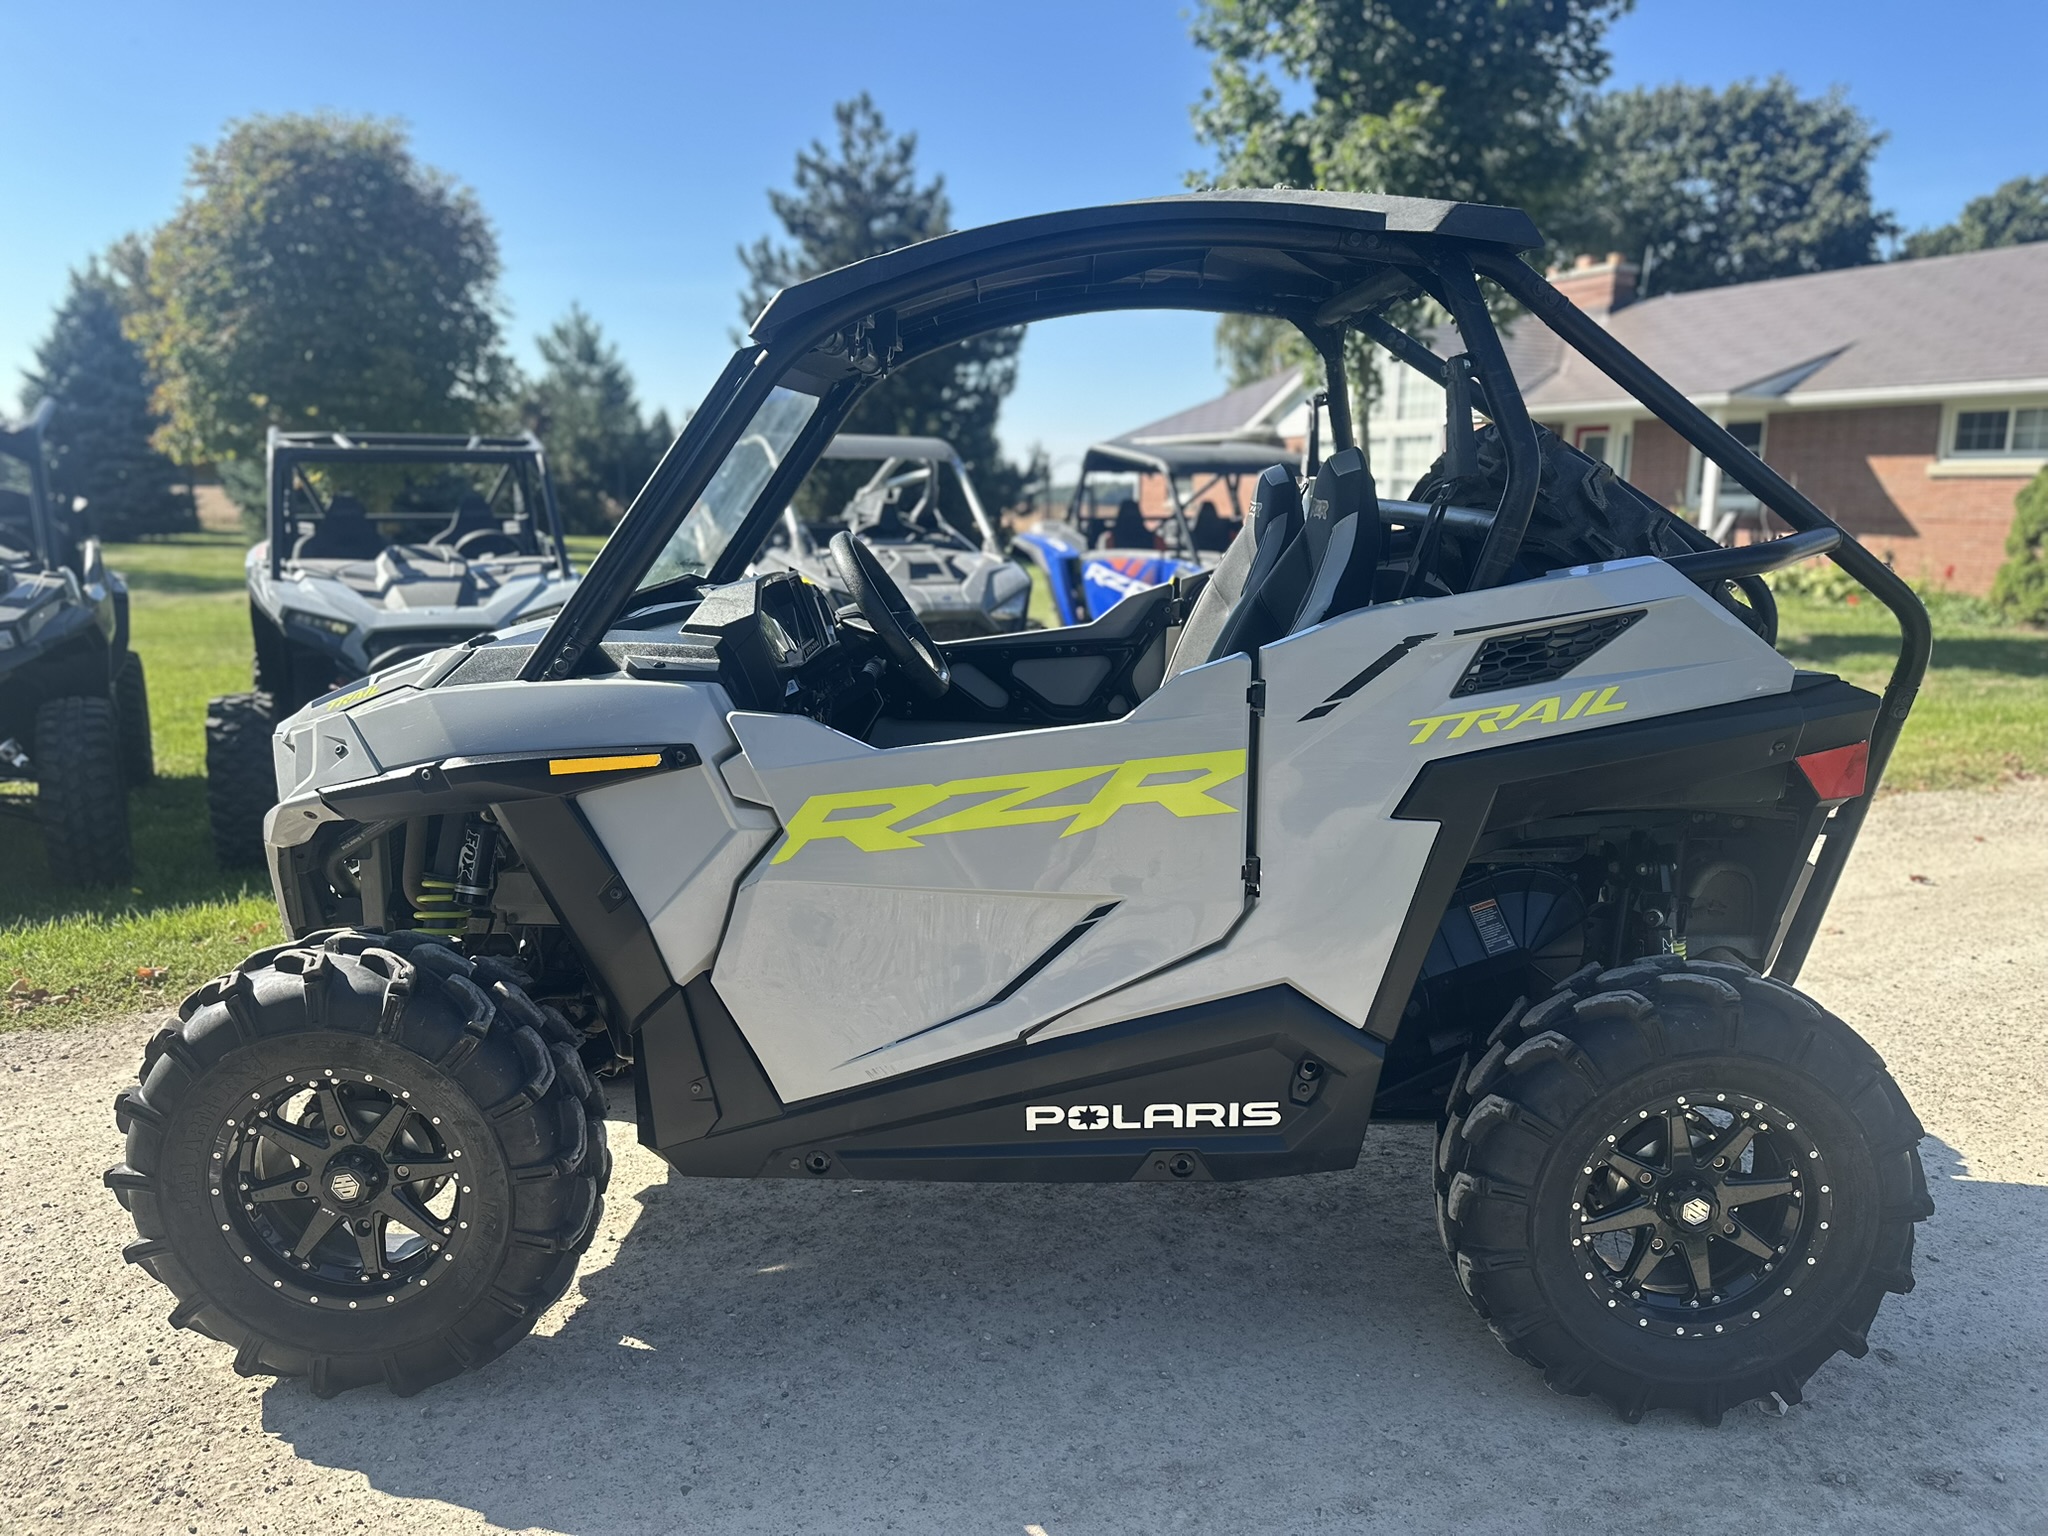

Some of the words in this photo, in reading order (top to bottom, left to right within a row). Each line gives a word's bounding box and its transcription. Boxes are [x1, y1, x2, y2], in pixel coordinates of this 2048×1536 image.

[327, 684, 379, 711] TRAIL
[1408, 686, 1628, 745] TRAIL
[769, 748, 1247, 864] RZR
[457, 829, 480, 881] FOX
[1025, 1101, 1282, 1131] POLARIS
